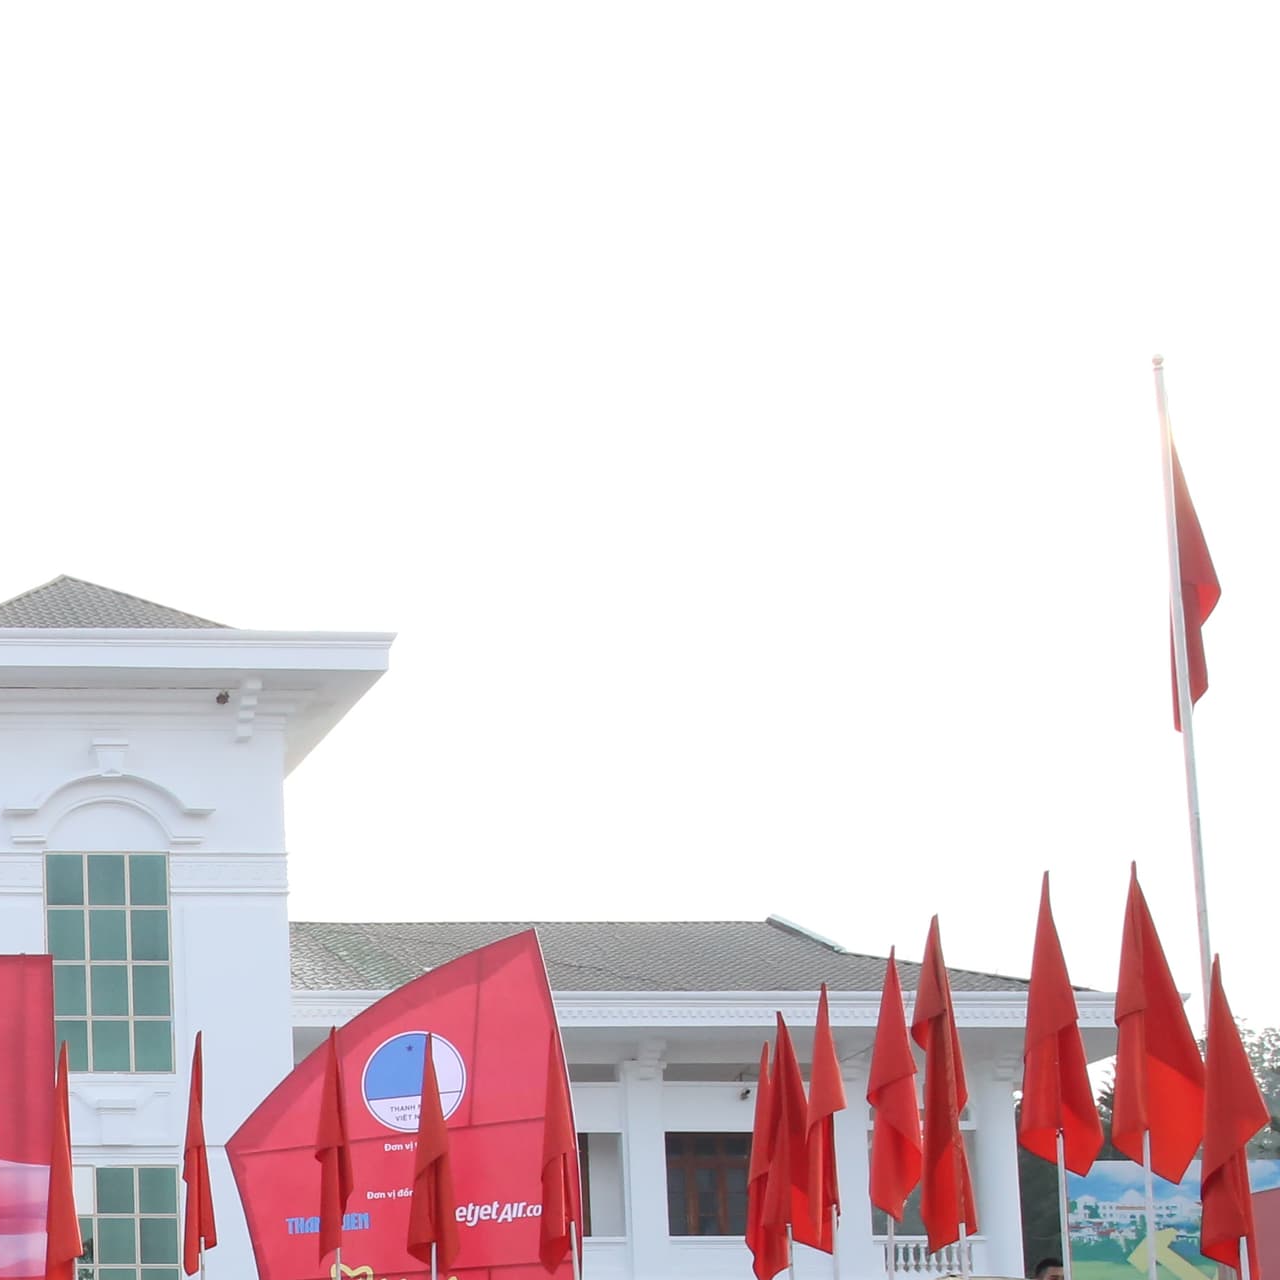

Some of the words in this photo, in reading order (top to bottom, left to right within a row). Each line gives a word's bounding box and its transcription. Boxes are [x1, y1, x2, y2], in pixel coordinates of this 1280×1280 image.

[390, 1104, 416, 1112] THANH
[384, 1143, 403, 1151] Đơn
[367, 1191, 386, 1200] Đơn
[455, 1201, 542, 1227] etjetAir.co
